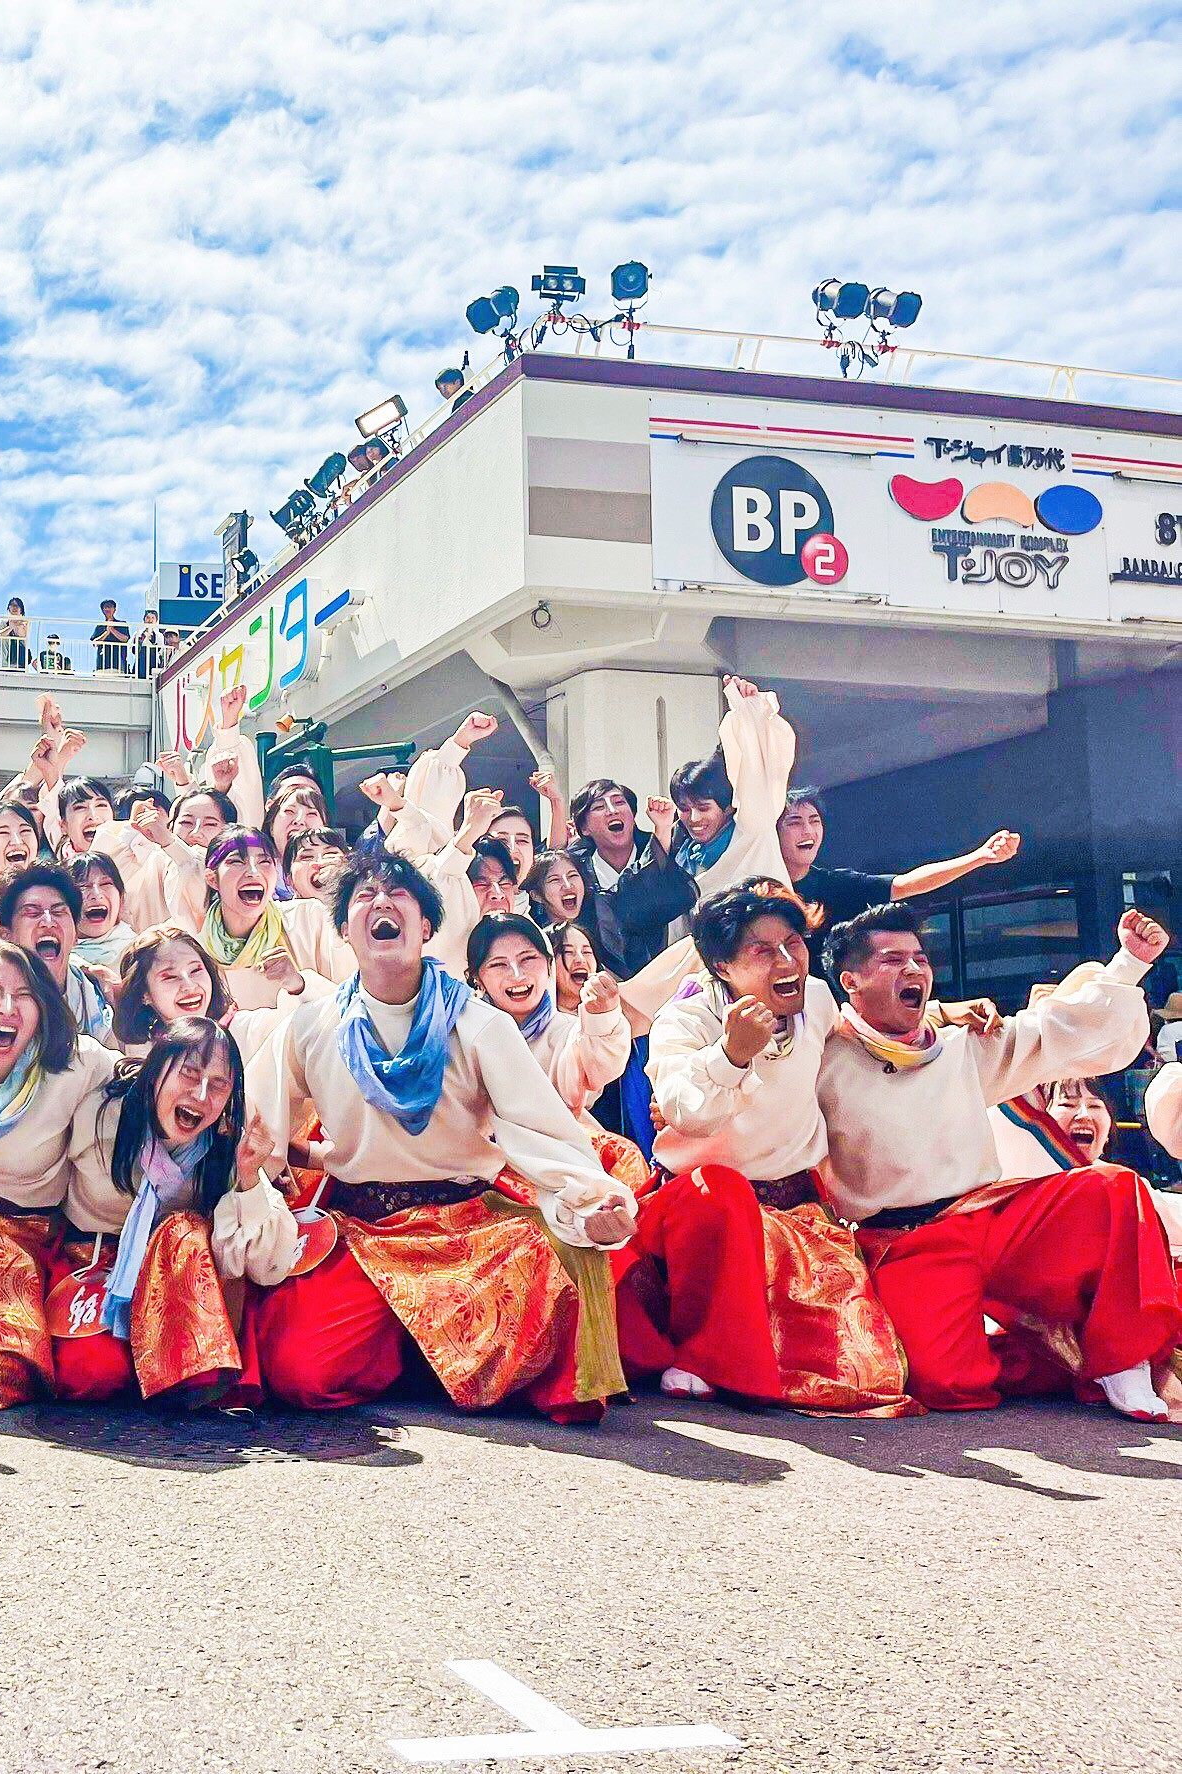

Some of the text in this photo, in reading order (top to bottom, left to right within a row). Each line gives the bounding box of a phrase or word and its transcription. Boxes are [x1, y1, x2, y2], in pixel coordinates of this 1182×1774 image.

[732, 486, 820, 555] BP
[815, 543, 836, 577] 2
[173, 576, 351, 753] バスセンター
